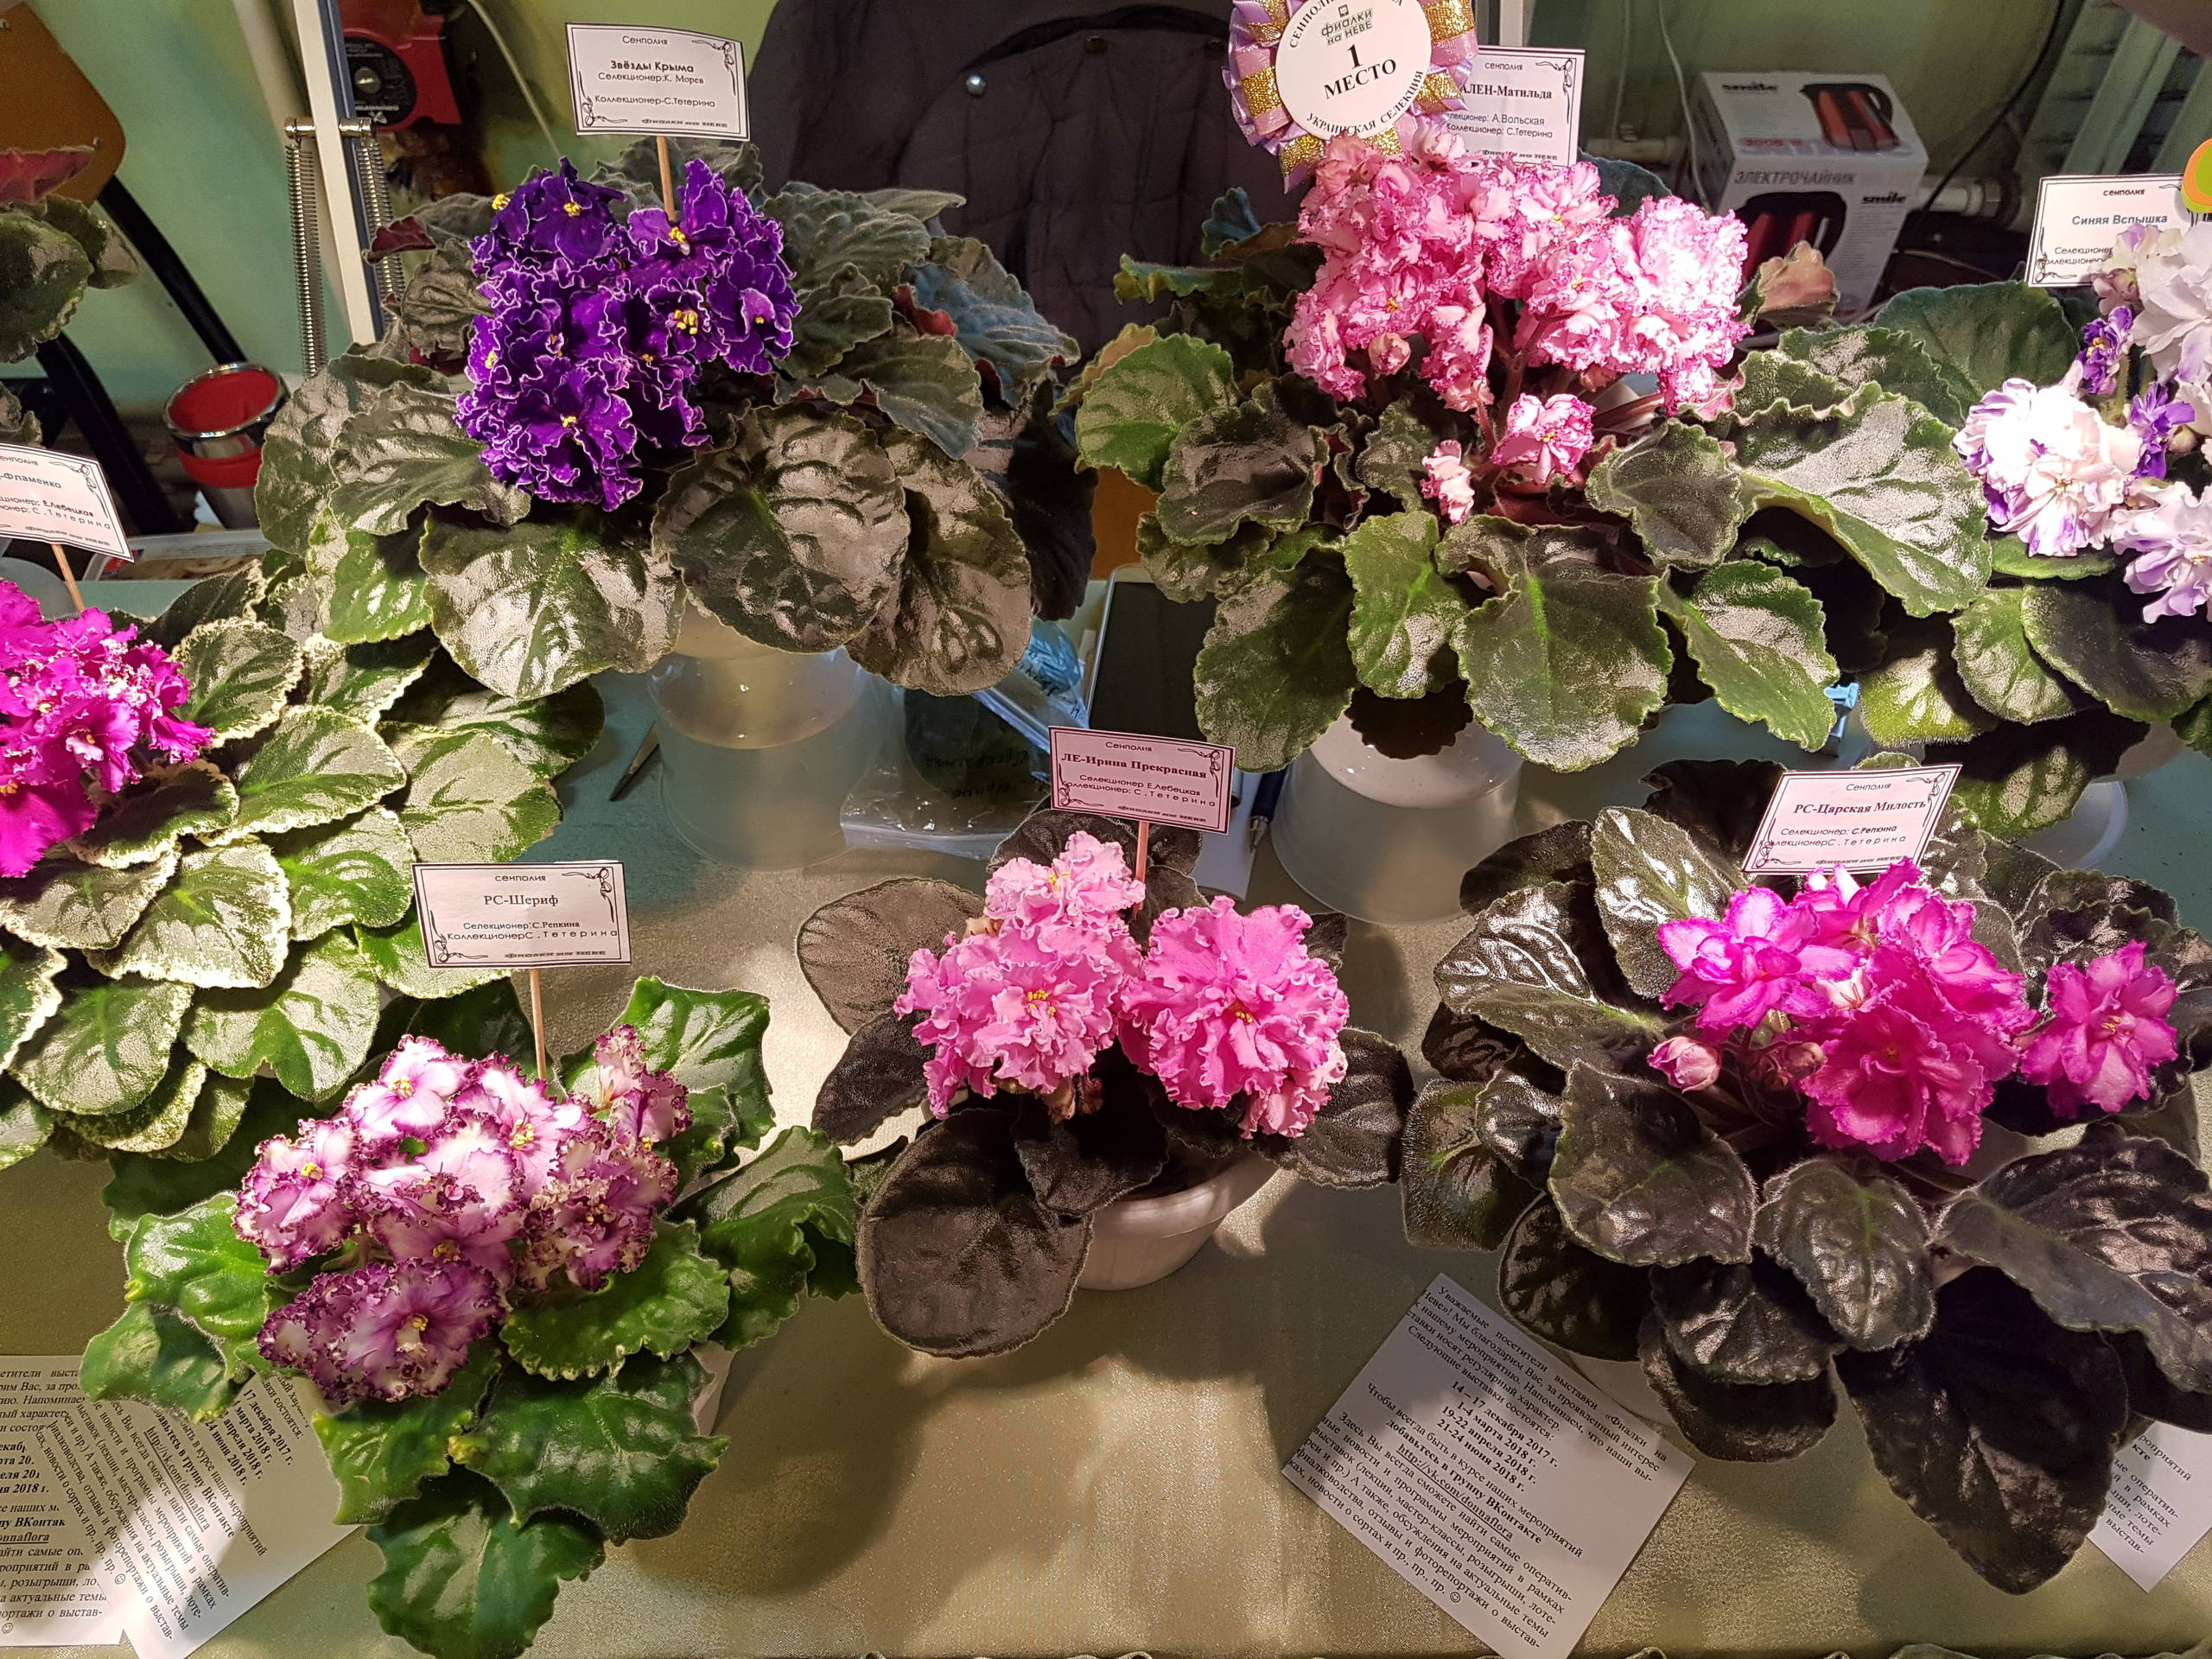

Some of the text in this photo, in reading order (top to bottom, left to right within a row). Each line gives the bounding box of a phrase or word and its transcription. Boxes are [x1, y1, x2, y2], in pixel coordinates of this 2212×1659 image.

[622, 35, 668, 46] Сенполия
[610, 60, 694, 73] Звёзды Крыма
[1347, 44, 1363, 69] 1
[1484, 62, 1523, 71] сенполия
[675, 74, 704, 85] Морев
[1323, 59, 1396, 99] МЕСТО
[1380, 71, 1423, 124] СЕЛЕКЦИЯ
[1491, 113, 1545, 125] А.Вольская
[1506, 128, 1553, 138] С.Тетерина
[2103, 188, 2145, 197] сенполия
[2071, 214, 2168, 226] Синяя Вспышка
[0, 456, 39, 467] енполия
[1105, 741, 1152, 752] Сенполия
[1061, 753, 1207, 779] ЛЕ-Ирина Прекрасная
[1079, 774, 1200, 797] Селекционер Е.Лебецкая
[1845, 783, 1891, 791] Сенполия
[1793, 799, 1926, 815] РС-Царская Милость
[1781, 824, 1897, 836] Селекционер: С.Репкина
[484, 894, 559, 907] РС-Шериф
[1408, 1325, 1554, 1441] Следующие выставки состоятся:
[1438, 1286, 1667, 1462] Уважаемые посетители выставки «Фиалки на
[243, 1389, 257, 1401] 17
[1452, 1312, 1471, 1331] Мы
[1471, 1326, 1524, 1371] благодарим
[1524, 1367, 1543, 1388] Вас,
[1546, 1383, 1557, 1395] за
[1557, 1393, 1621, 1443] проявленный
[1620, 1440, 1660, 1472] интерес
[248, 1401, 276, 1437] декабря
[1452, 1381, 1465, 1394] 14
[1471, 1396, 1486, 1408] 17
[1483, 1408, 1525, 1441] декабря
[1525, 1438, 1551, 1459] 2017
[1549, 1457, 1558, 1468] г.
[223, 1418, 246, 1451] апреля
[242, 1447, 262, 1471] 2018
[272, 1433, 291, 1456] 2017
[1442, 1405, 1536, 1484] 19-22 апреля 2018 г.
[1457, 1401, 1536, 1468] 1-4 марта 2018 г.
[212, 1430, 232, 1457] июня
[226, 1453, 246, 1477] 2018
[1437, 1418, 1524, 1492] 21-24 июня 2018 г.
[2137, 1433, 2192, 1481] роприятий
[143, 1426, 211, 1533] http://vk.com/donnaflora
[1368, 1382, 1396, 1411] Чтобы
[1395, 1408, 1426, 1436] всегда
[1427, 1432, 1449, 1455] быть
[1458, 1459, 1485, 1483] курсе
[1485, 1480, 1518, 1509] наших
[1517, 1505, 1584, 1558] мероприятий
[1385, 1419, 1541, 1544] добавьтесь в группу ВКонтакте
[12, 1484, 38, 1494] 2018
[178, 1448, 239, 1538] в группу ВКонтакте
[1395, 1443, 1513, 1542] http://vk.com/donnaflora
[2130, 1474, 2179, 1519] оператив-
[120, 1414, 229, 1598] Вы всегда сможете найти самые оператив-
[1339, 1411, 1572, 1601] Здесь Вы всегда сможете найти самые оператив-
[2133, 1495, 2171, 1528] рамках
[14, 1517, 66, 1527] ВКонтак
[1287, 1459, 1306, 1479] ках,
[1306, 1475, 1344, 1510] новости
[1352, 1514, 1385, 1543] сортах
[1383, 1541, 1393, 1549] и
[1392, 1547, 1409, 1567] пр.,
[1411, 1562, 1428, 1582] пр.,
[1430, 1578, 1445, 1594] пр.
[2126, 1519, 2154, 1546] темы
[2133, 1511, 2162, 1535] лоте-
[2105, 1517, 2144, 1554] выстав-
[10, 1577, 79, 1589] розыгрыши,
[10, 1593, 76, 1604] актуальные
[48, 1607, 103, 1618] о выстав-
